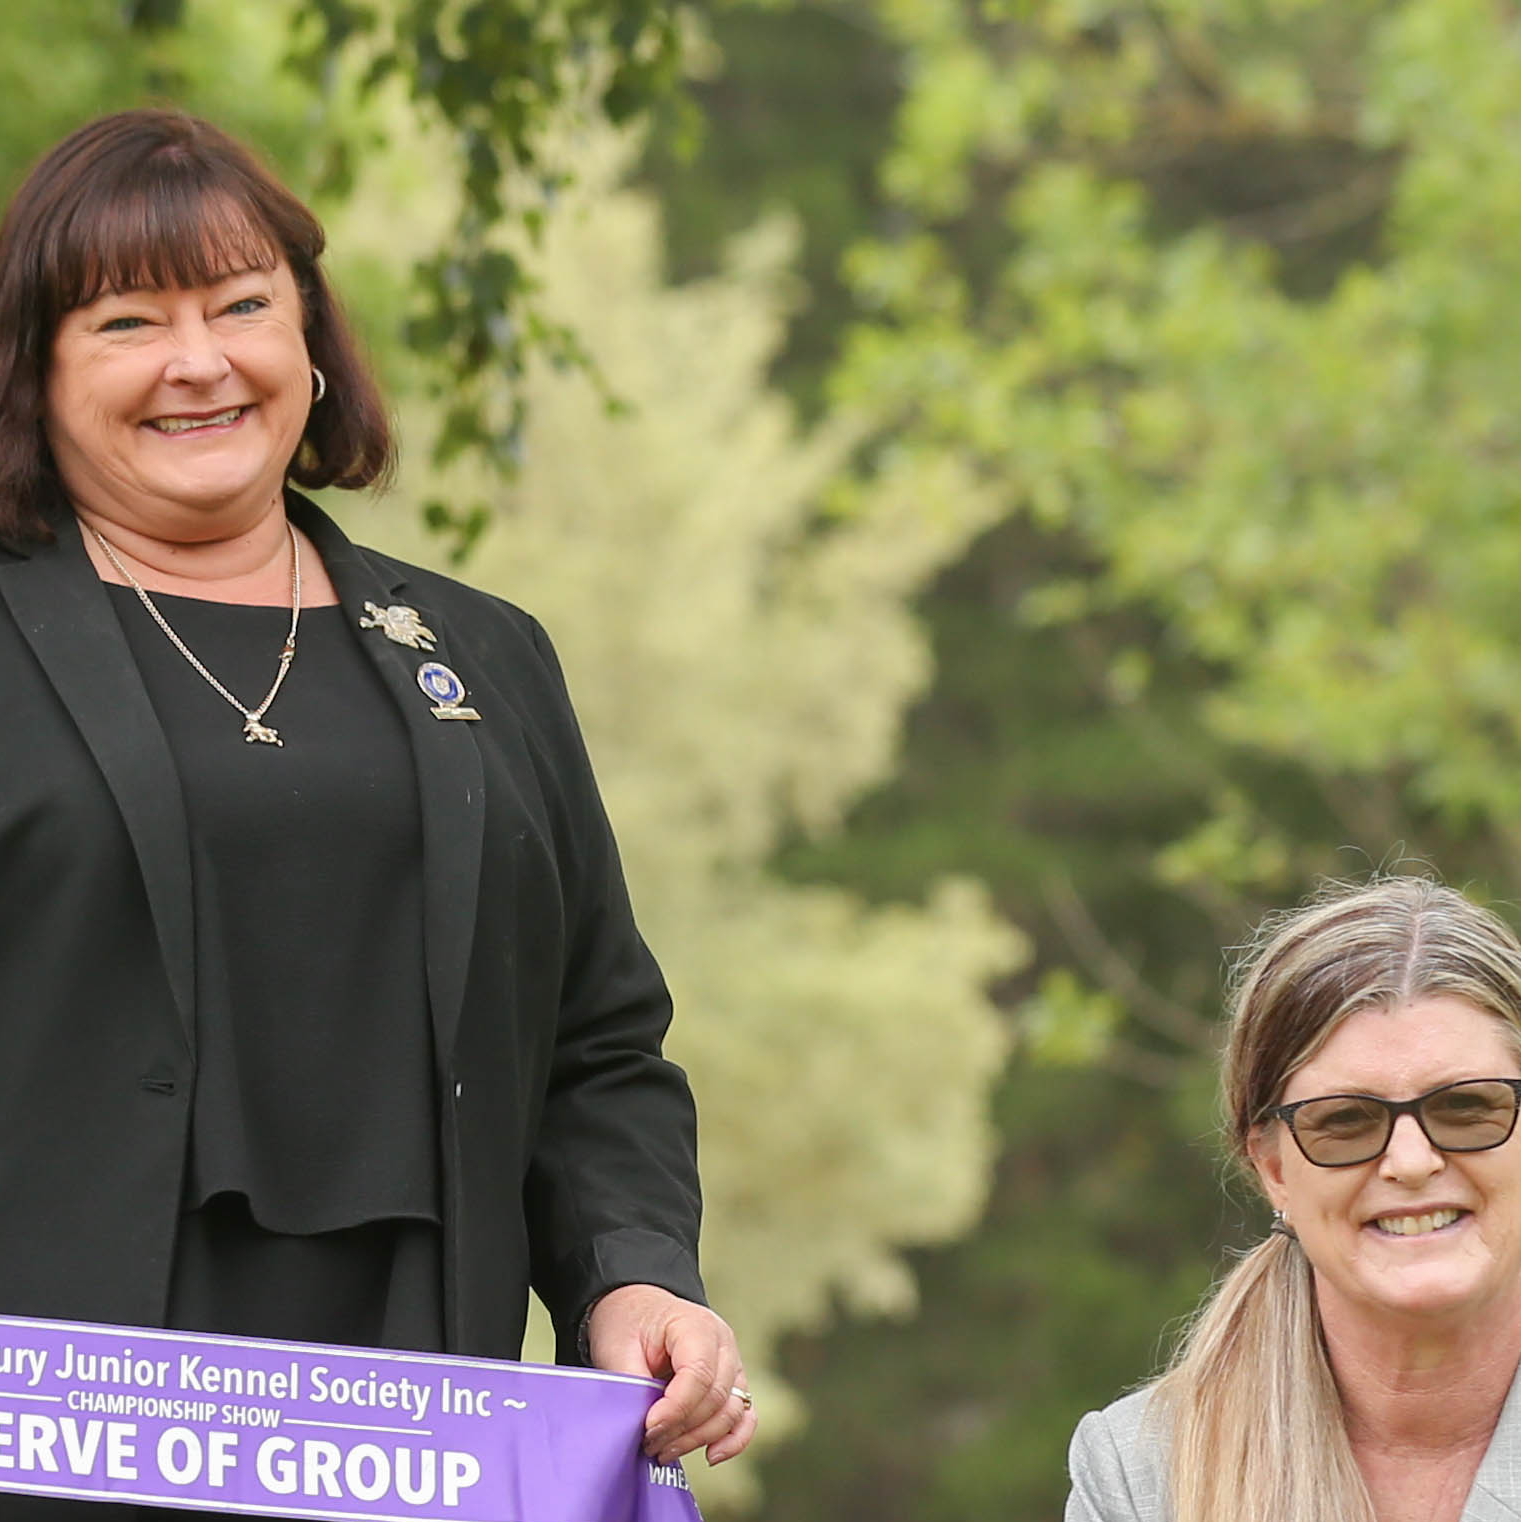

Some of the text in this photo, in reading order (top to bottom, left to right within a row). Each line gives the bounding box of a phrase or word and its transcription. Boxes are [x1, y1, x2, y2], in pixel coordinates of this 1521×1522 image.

[55, 1344, 170, 1388] Junior
[179, 1354, 299, 1400] Kennel
[309, 1366, 431, 1421] Society
[442, 1378, 491, 1417] Inc
[67, 1390, 281, 1428] CHAMPIONSHIP SHOW
[157, 1426, 238, 1487] OF
[256, 1435, 480, 1506] GROUP
[648, 1462, 689, 1491] WHE
